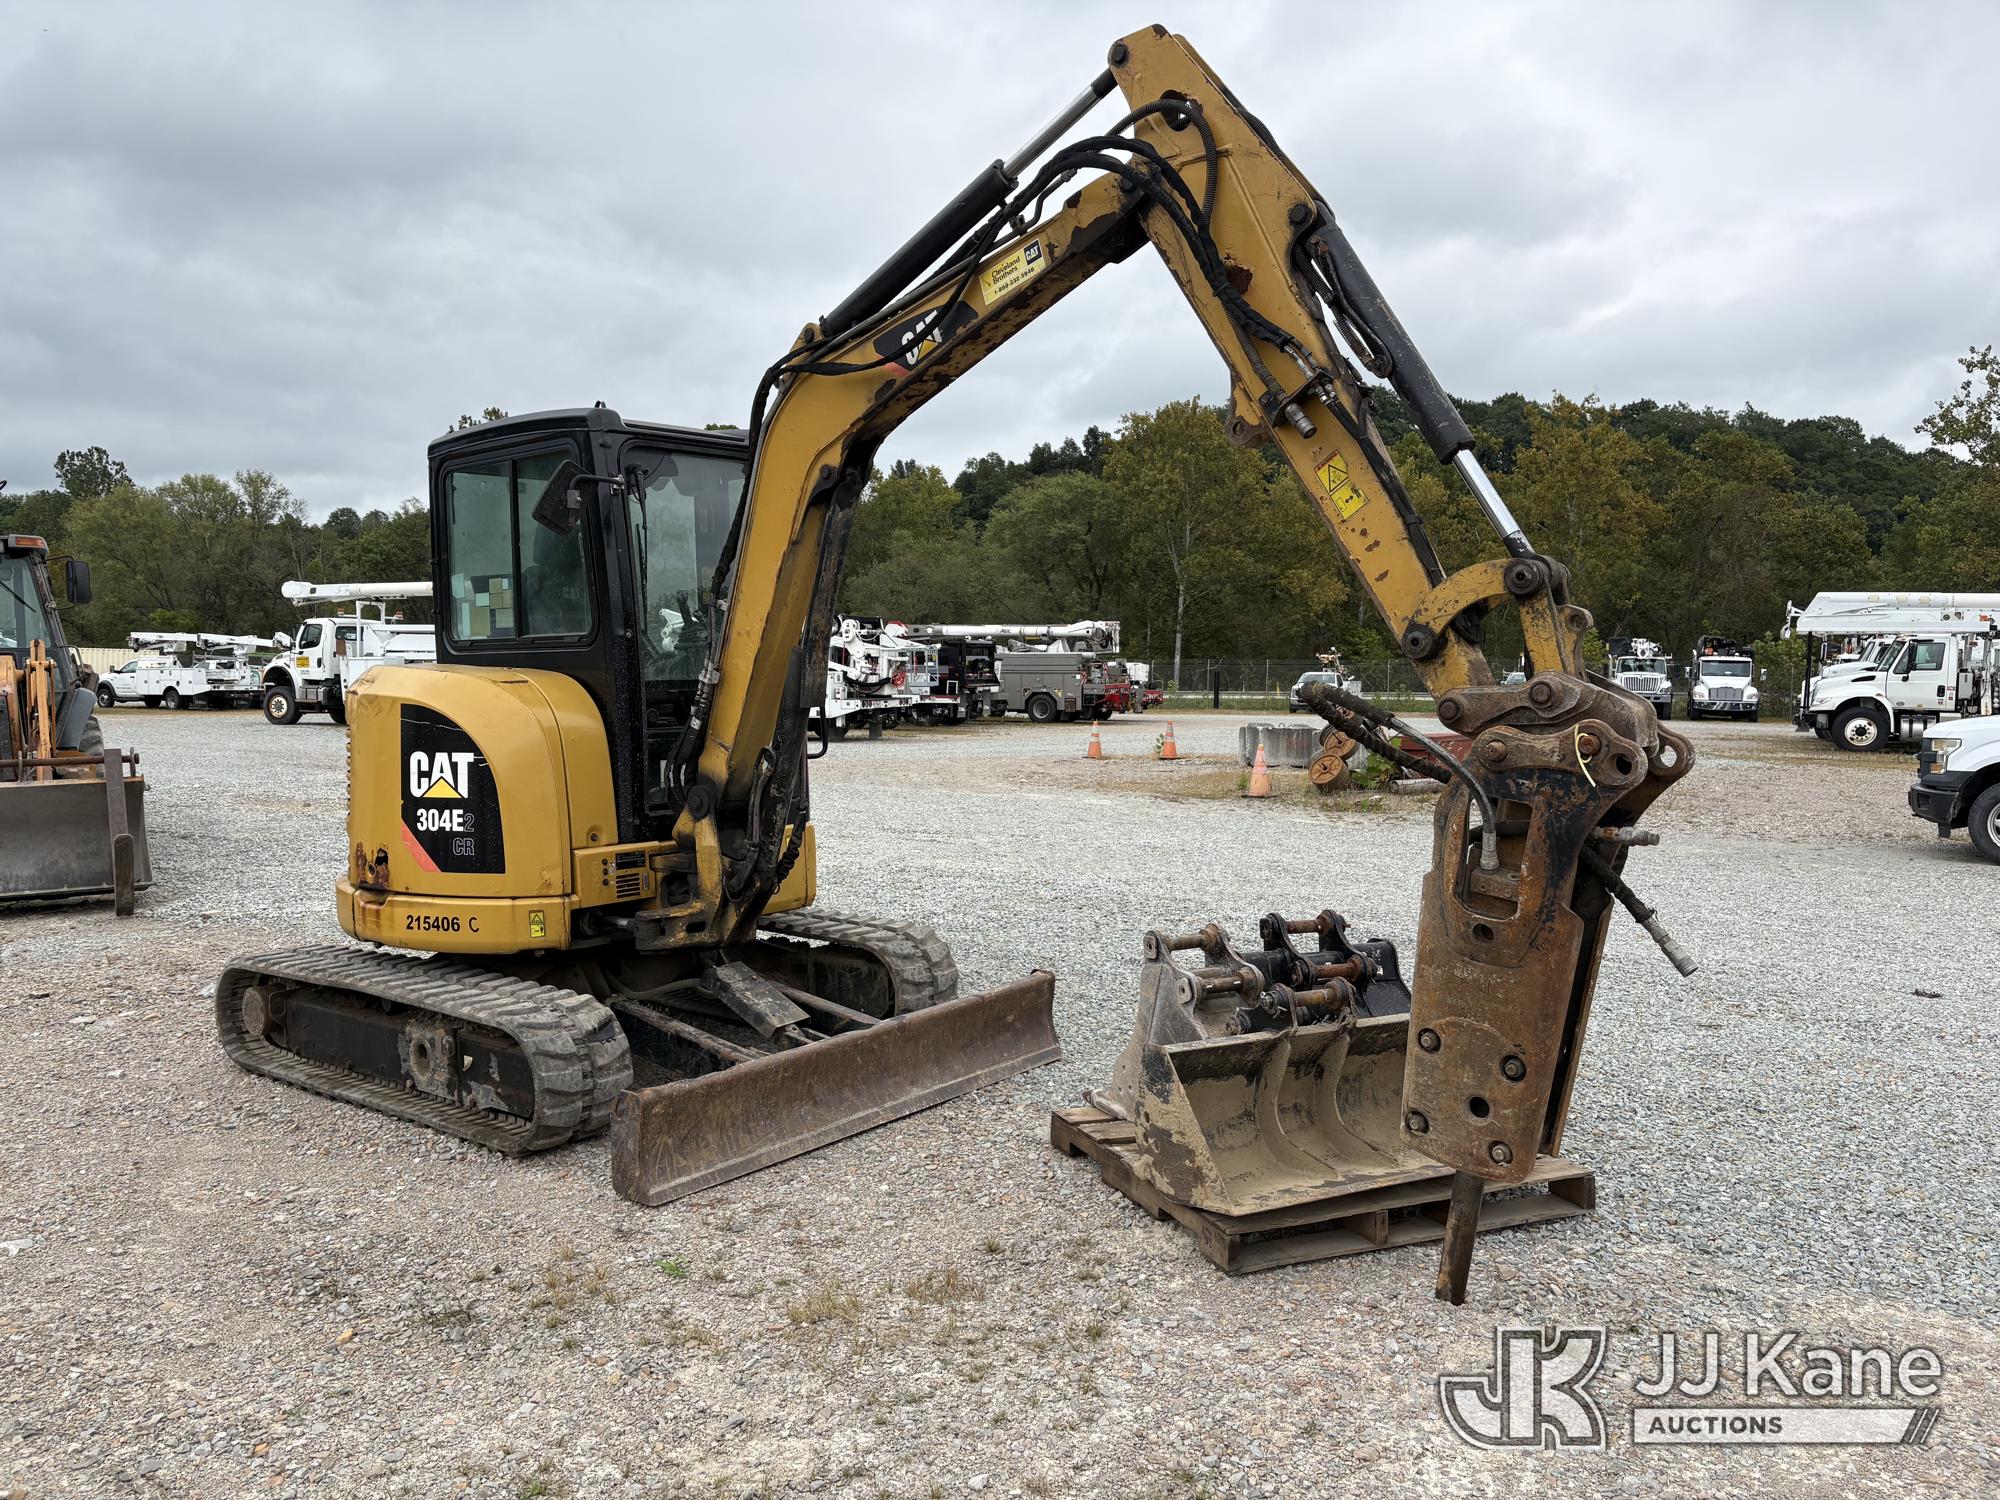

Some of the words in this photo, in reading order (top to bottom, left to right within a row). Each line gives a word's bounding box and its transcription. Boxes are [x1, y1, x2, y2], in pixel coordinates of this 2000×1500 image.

[1025, 244, 1039, 261] CAT
[991, 255, 1021, 278] Cleveland
[992, 265, 1018, 285] Brothers
[409, 750, 475, 799] CAT
[416, 808, 475, 833] 304E2
[452, 837, 475, 856] CR
[405, 914, 461, 933] 215406
[468, 916, 480, 933] C
